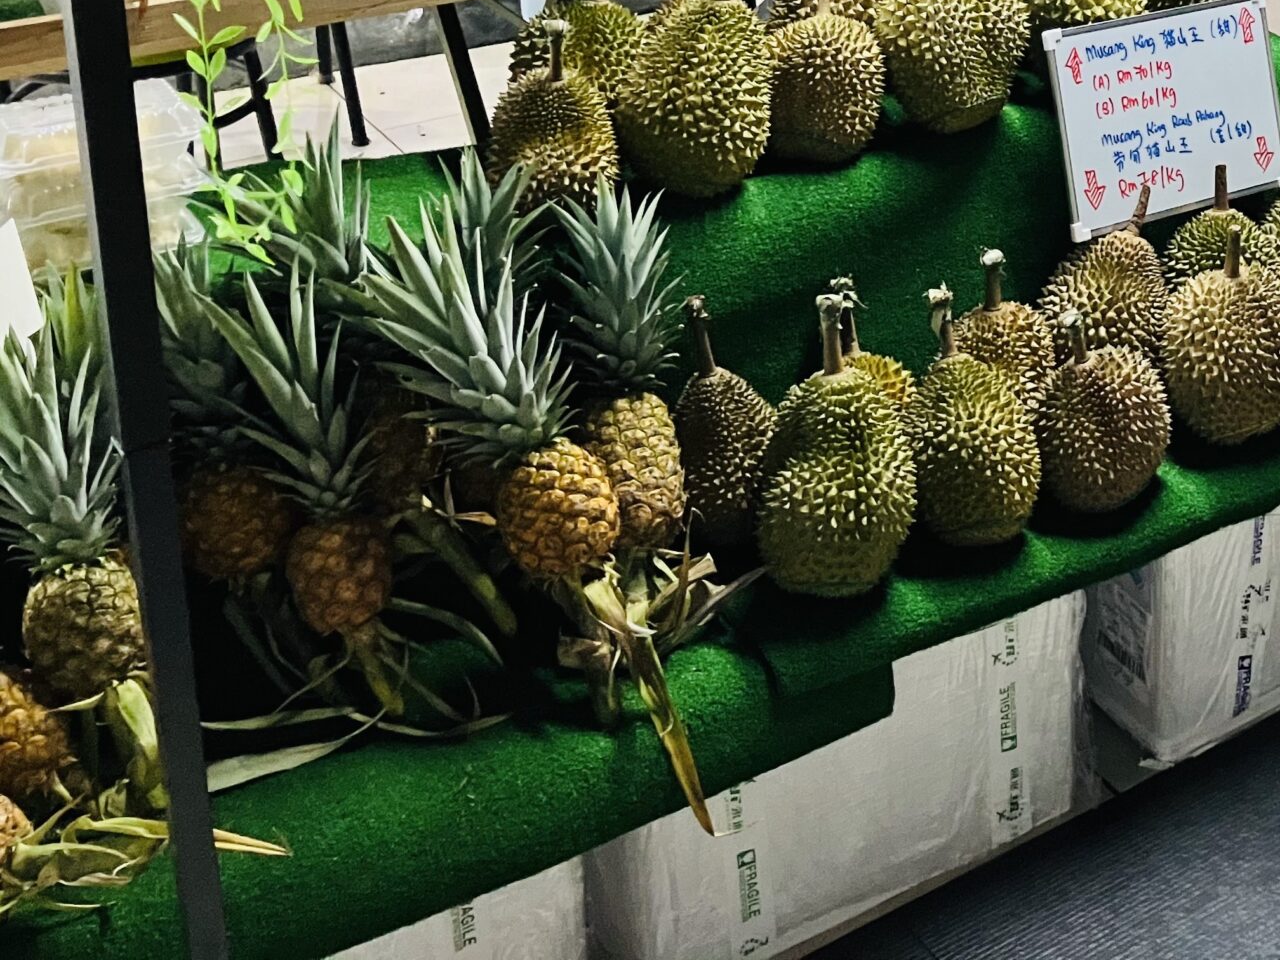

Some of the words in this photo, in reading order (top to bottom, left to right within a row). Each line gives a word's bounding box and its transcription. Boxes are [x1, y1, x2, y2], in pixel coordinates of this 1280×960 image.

[1085, 43, 1128, 62] Musang
[1132, 34, 1156, 54] King
[1092, 73, 1110, 92] (A)
[1146, 121, 1167, 138] King
[999, 685, 1011, 737] FRAGILE
[746, 863, 761, 918] FRAGILE
